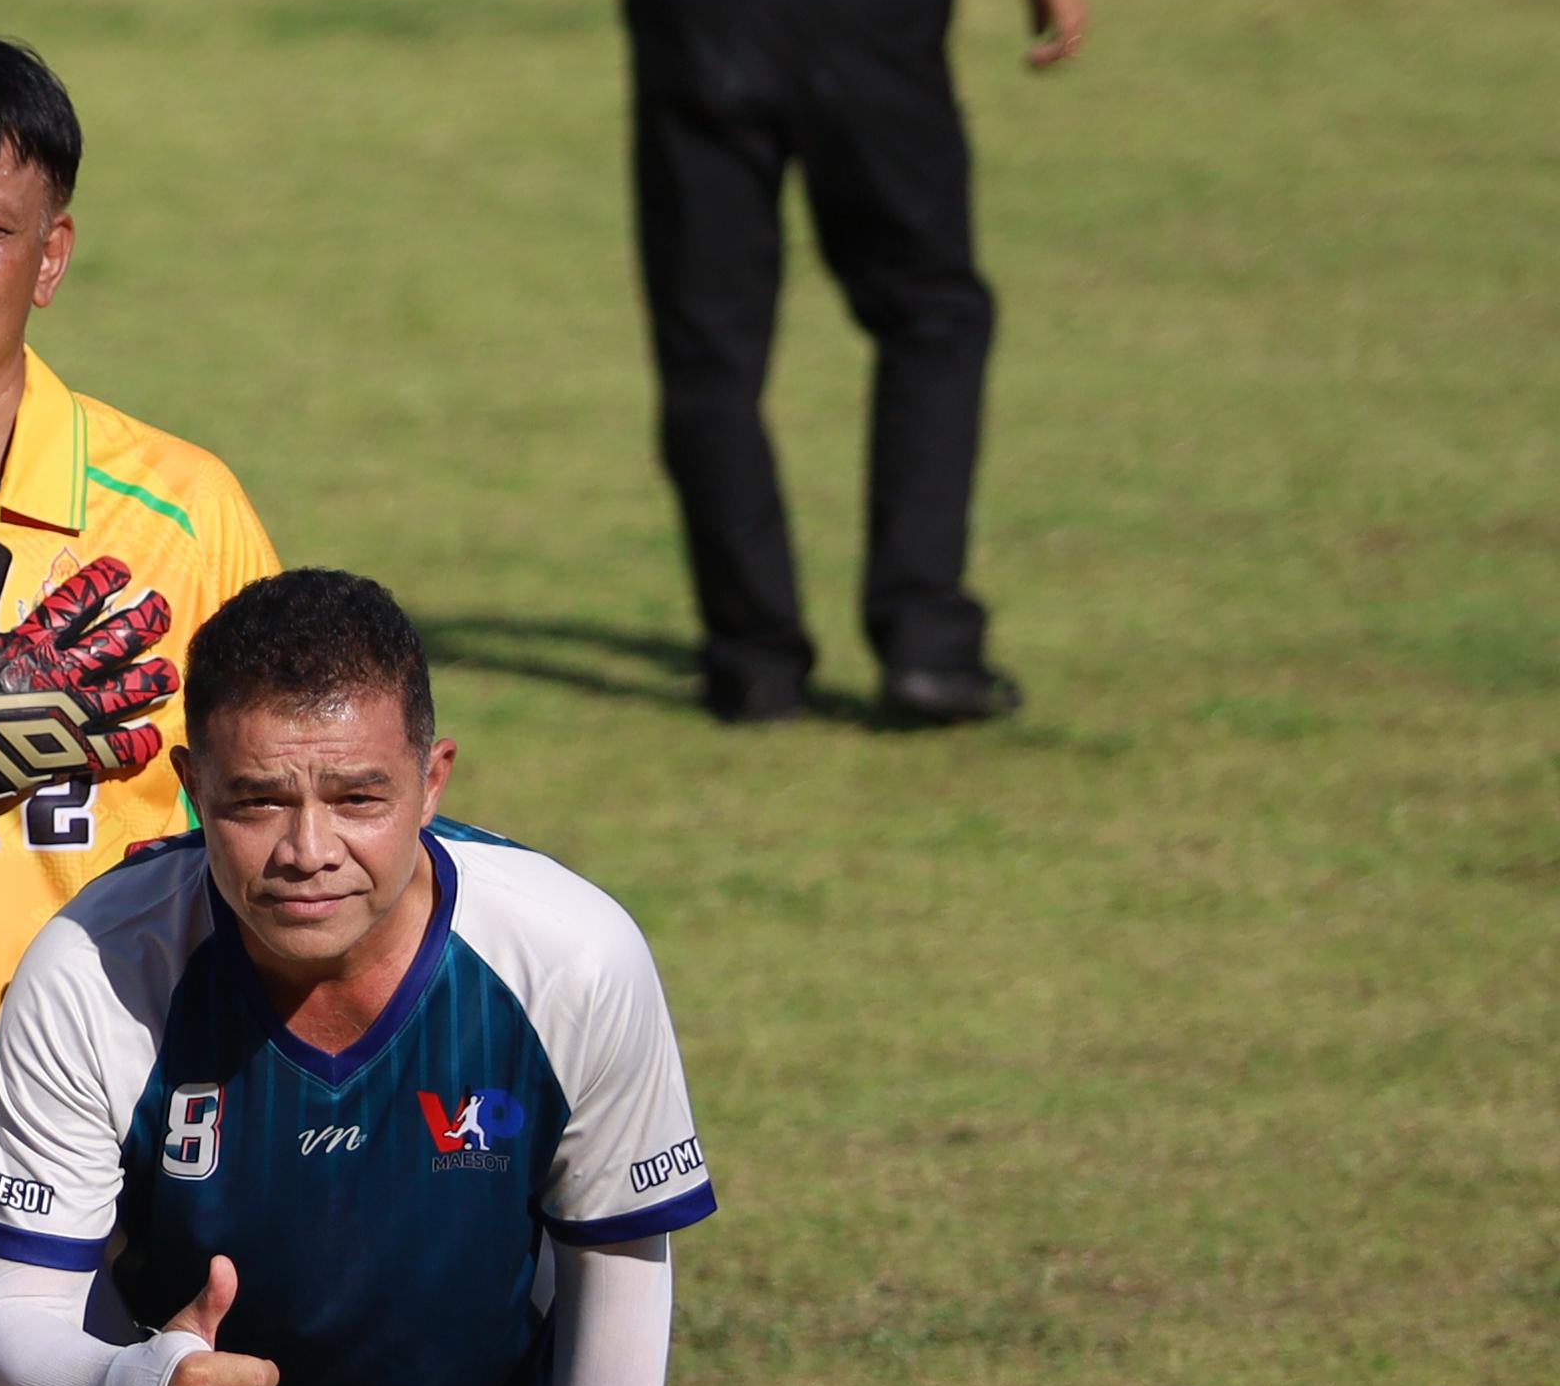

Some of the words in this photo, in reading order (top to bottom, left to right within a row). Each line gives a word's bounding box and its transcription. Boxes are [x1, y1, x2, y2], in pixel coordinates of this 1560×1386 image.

[161, 1082, 225, 1181] 8
[432, 1151, 511, 1173] MAESOT
[630, 1151, 672, 1193] VIP
